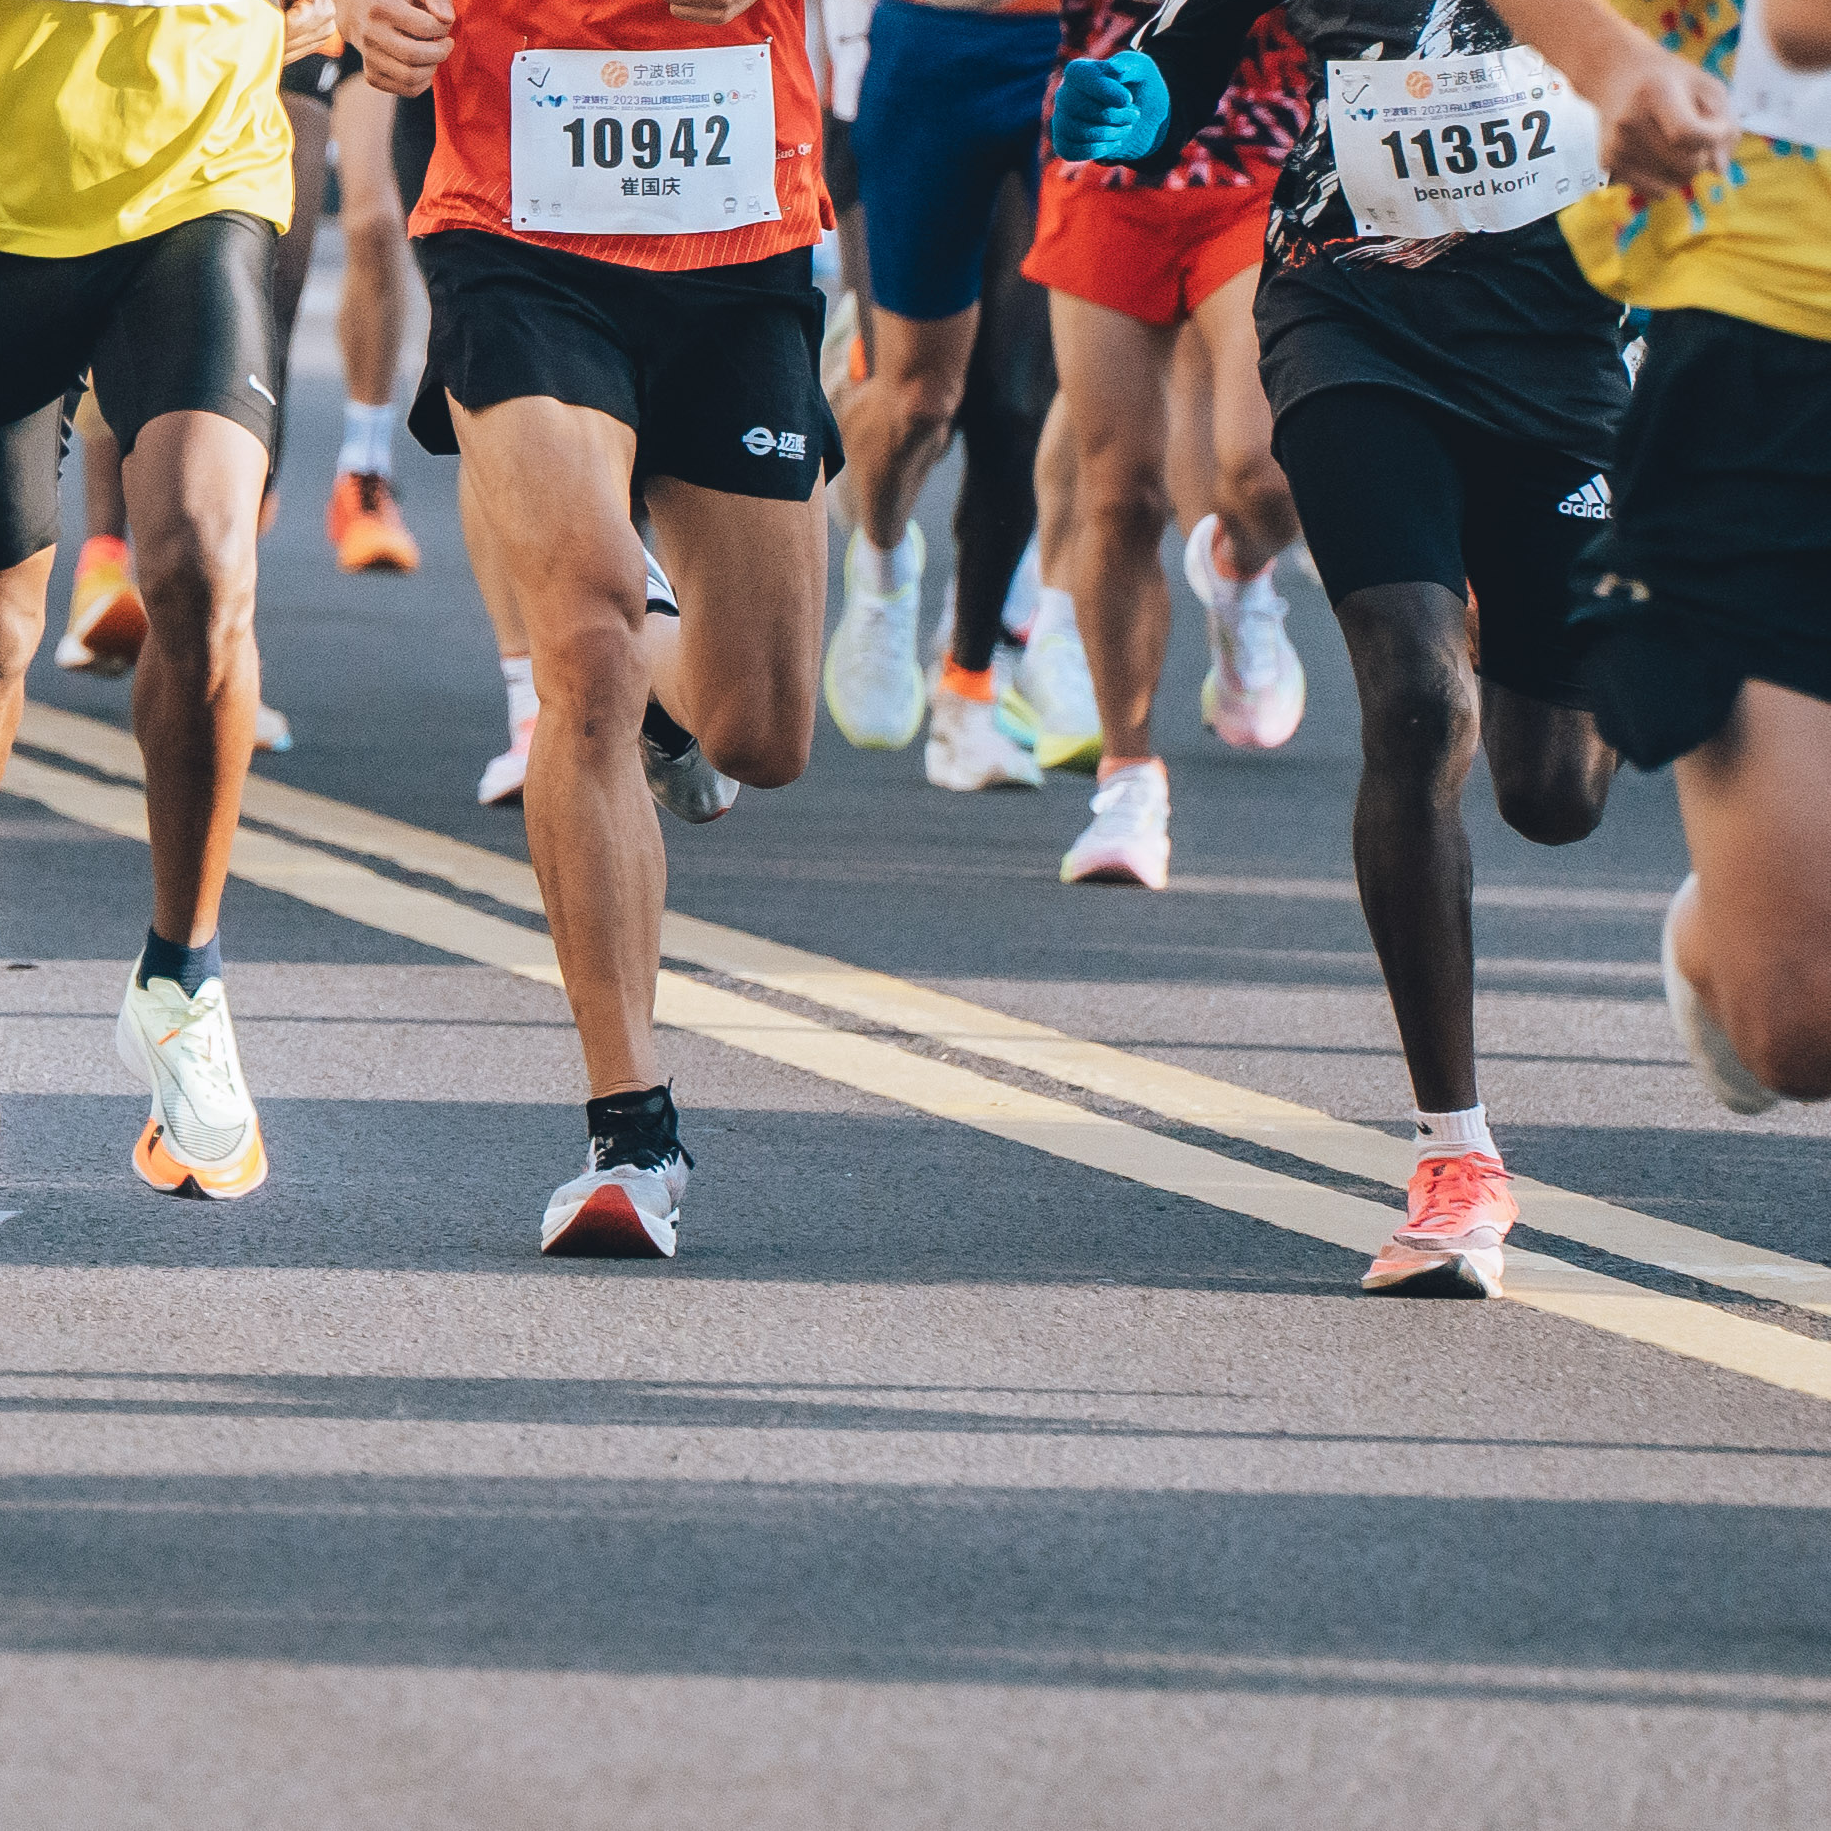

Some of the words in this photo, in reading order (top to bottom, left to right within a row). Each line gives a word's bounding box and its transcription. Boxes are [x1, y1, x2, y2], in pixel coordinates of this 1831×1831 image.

[633, 62, 695, 79] 宁波银行
[1436, 65, 1504, 87] 宁波银行
[562, 114, 731, 169] 10942
[1381, 110, 1556, 179] 11352
[620, 176, 681, 196] 崔国庆
[1413, 180, 1485, 202] benard
[1490, 171, 1539, 195] korir
[1558, 501, 1613, 519] adid
